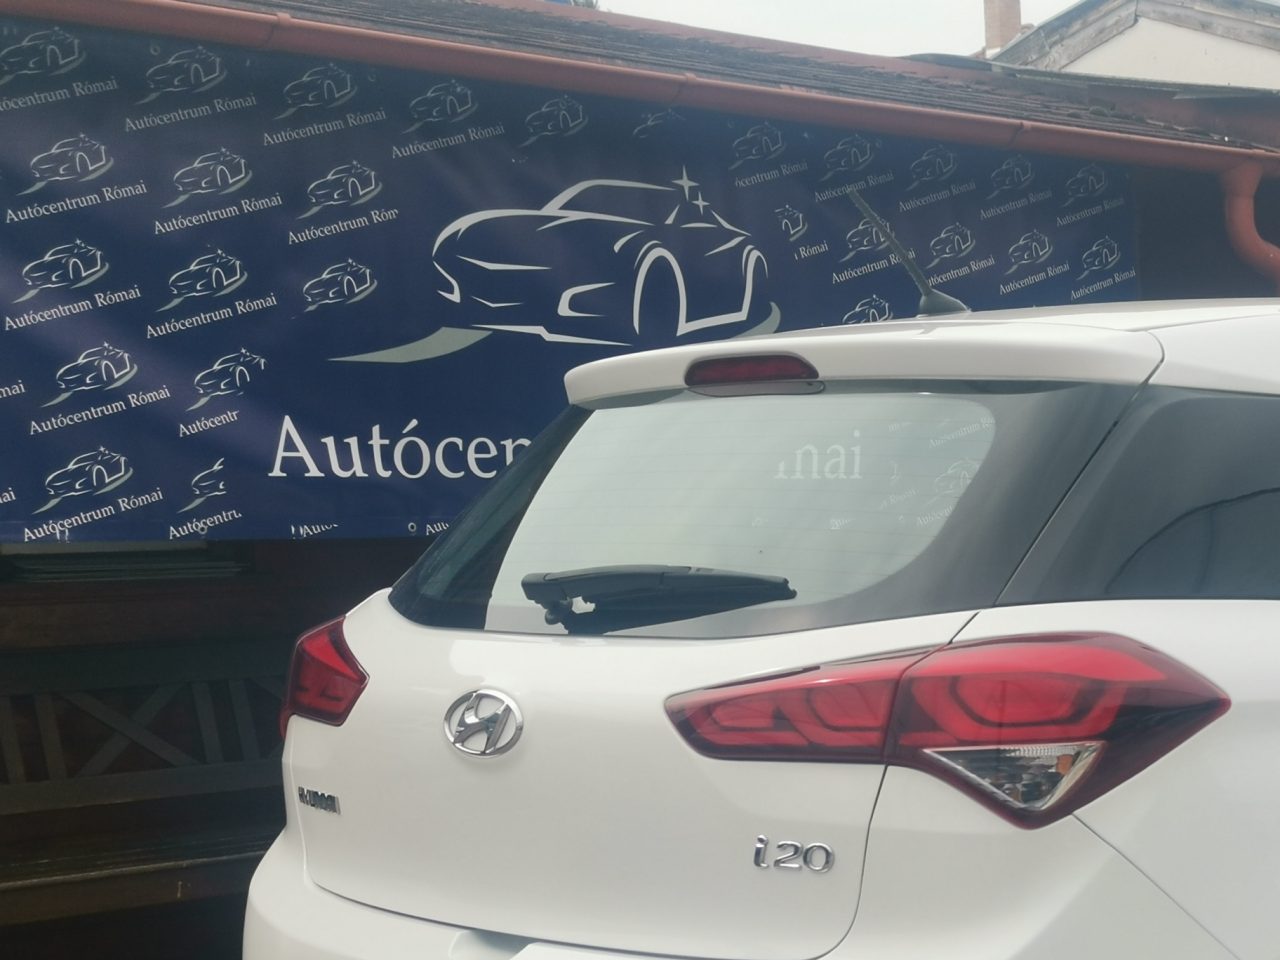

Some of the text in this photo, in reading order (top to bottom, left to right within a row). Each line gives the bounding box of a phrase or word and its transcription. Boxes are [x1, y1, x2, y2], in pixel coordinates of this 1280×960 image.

[72, 75, 118, 97] Római
[125, 94, 257, 132] Autócentrum Római
[263, 107, 387, 146] Autócentrum Római
[392, 122, 505, 159] Autócentrum Római
[6, 179, 147, 223] Autócentrum Római
[154, 192, 283, 235] Autócentrum Római
[899, 189, 950, 213] Autócentrum
[288, 215, 370, 245] Autócentrum
[798, 239, 829, 260] Római
[832, 247, 916, 284] Autócentrum Róai
[927, 253, 995, 287] utócentrum Római
[1000, 259, 1070, 296] Autócentrum Római
[1070, 265, 1136, 300] Autócentrum Római
[4, 284, 141, 331] Autócentrum Római
[146, 293, 278, 339] Autócentrum Római
[0, 379, 25, 399] mai
[29, 384, 171, 436] Autócentrum Római
[179, 409, 240, 438] Autócentr
[23, 487, 163, 542] Autócentrum Római
[753, 834, 835, 873] i20
